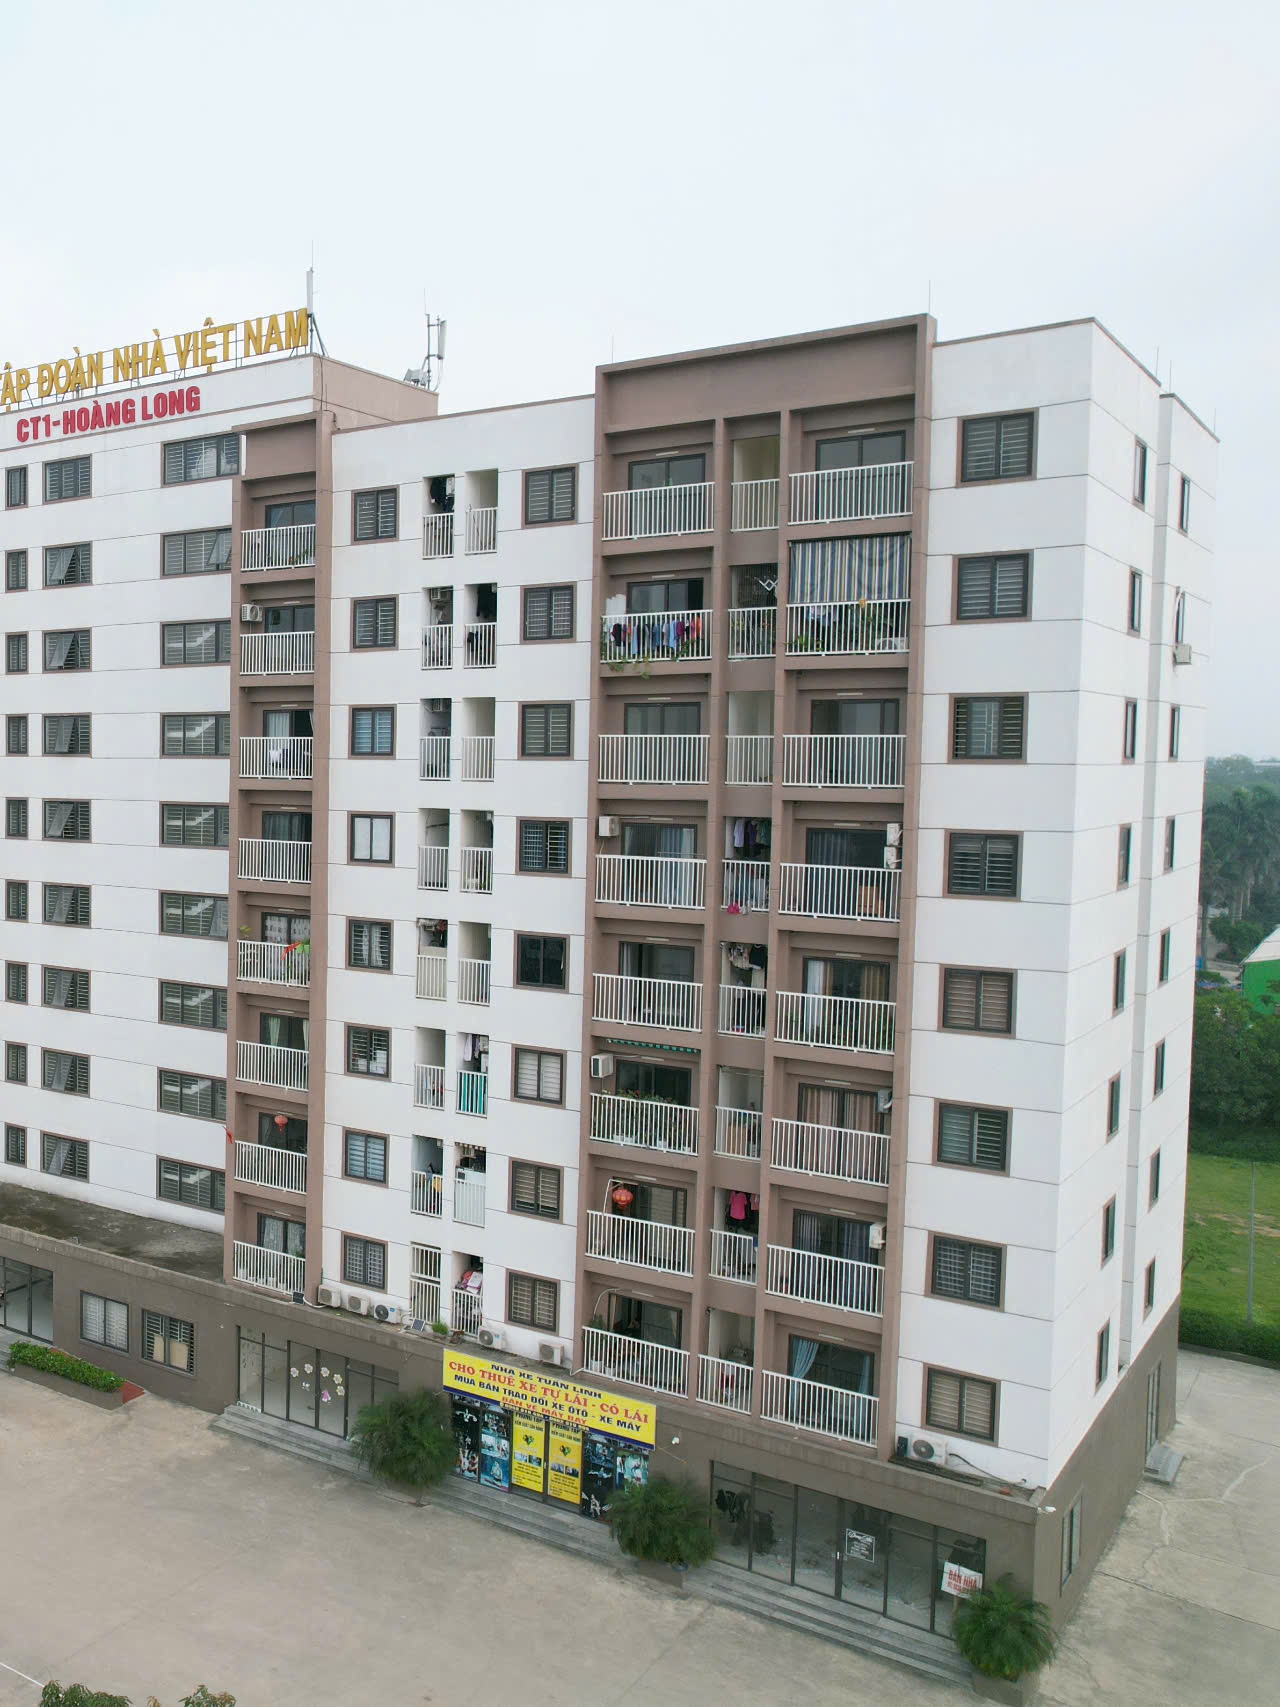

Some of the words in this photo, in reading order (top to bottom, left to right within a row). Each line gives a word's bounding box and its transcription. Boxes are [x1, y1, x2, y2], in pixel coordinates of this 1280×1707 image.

[37, 346, 103, 398] ĐOÀN
[113, 328, 167, 383] NHÀ
[174, 317, 236, 373] VIỆT
[244, 308, 309, 357] NAM
[16, 400, 136, 443] CT1-HOÀNG
[142, 385, 200, 421] LONG
[449, 1361, 475, 1375] CHO
[479, 1369, 515, 1386] THUÊ
[520, 1380, 537, 1393] XE
[564, 1392, 588, 1407] LÁI
[600, 1403, 619, 1415] CÓ
[624, 1408, 648, 1424] LÁI
[454, 1374, 475, 1386] MUA
[503, 1388, 527, 1400] TRAO
[552, 1401, 565, 1411] XE
[600, 1415, 613, 1424] XE
[617, 1419, 641, 1432] MÁY
[573, 1386, 602, 1399] LINH
